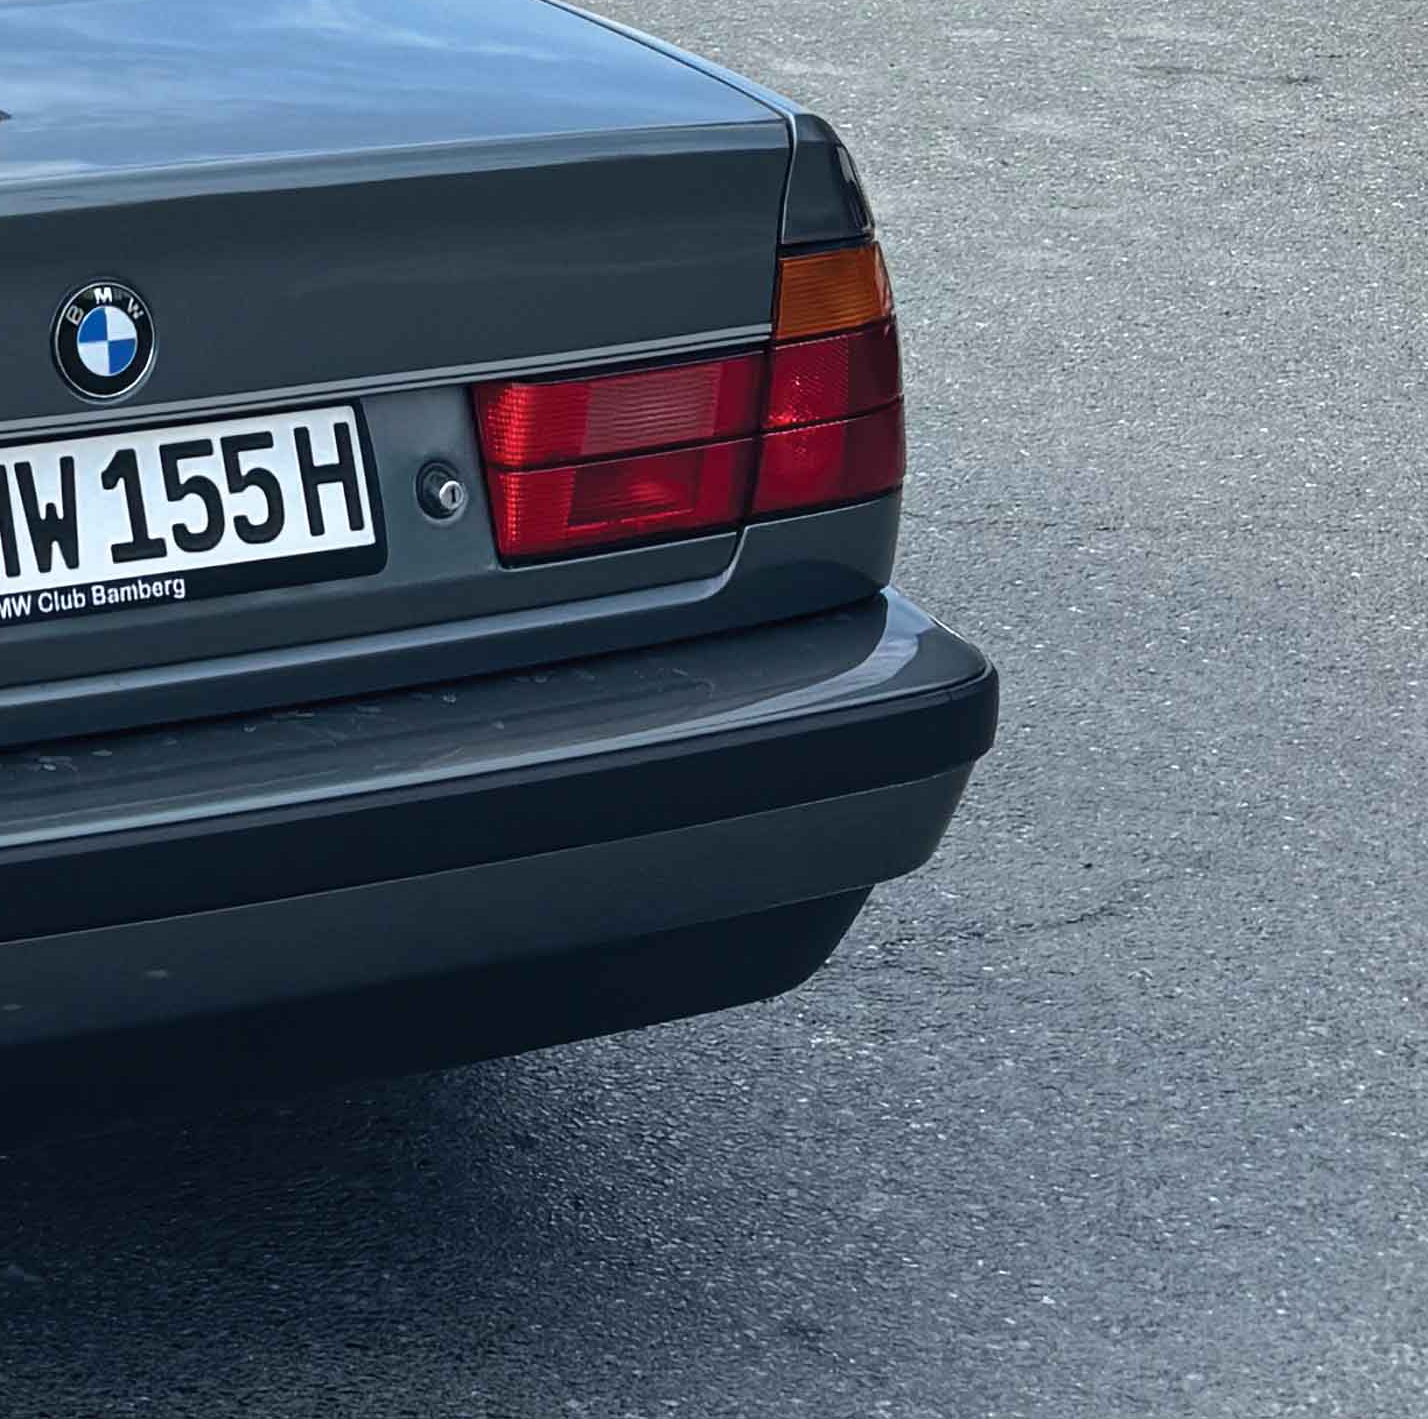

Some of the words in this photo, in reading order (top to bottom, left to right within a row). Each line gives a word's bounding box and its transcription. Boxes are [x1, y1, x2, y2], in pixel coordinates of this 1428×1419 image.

[65, 286, 144, 326] BMW
[38, 588, 87, 613] Club
[91, 578, 186, 606] Bamberg
